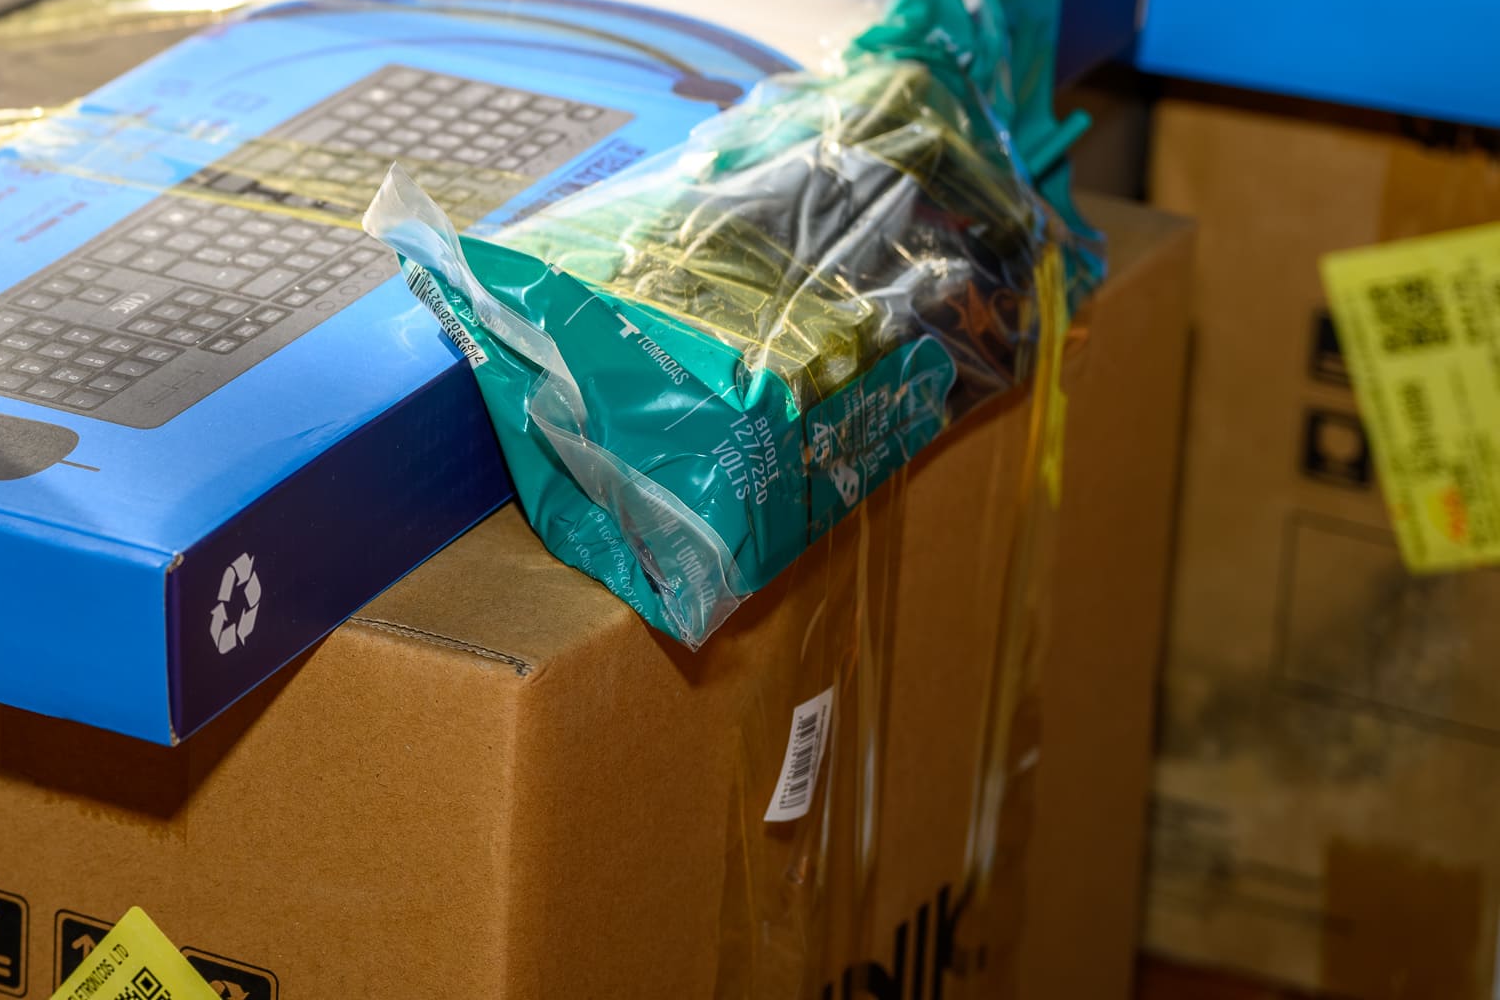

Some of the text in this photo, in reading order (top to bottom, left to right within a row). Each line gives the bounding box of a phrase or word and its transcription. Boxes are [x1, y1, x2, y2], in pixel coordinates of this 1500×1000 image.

[111, 296, 145, 315] NTC
[637, 335, 690, 387] TOMADAS
[710, 438, 752, 501] VOLTS
[729, 413, 769, 505] 127/220
[753, 416, 781, 482] BIVOLT
[109, 943, 130, 966] LTD
